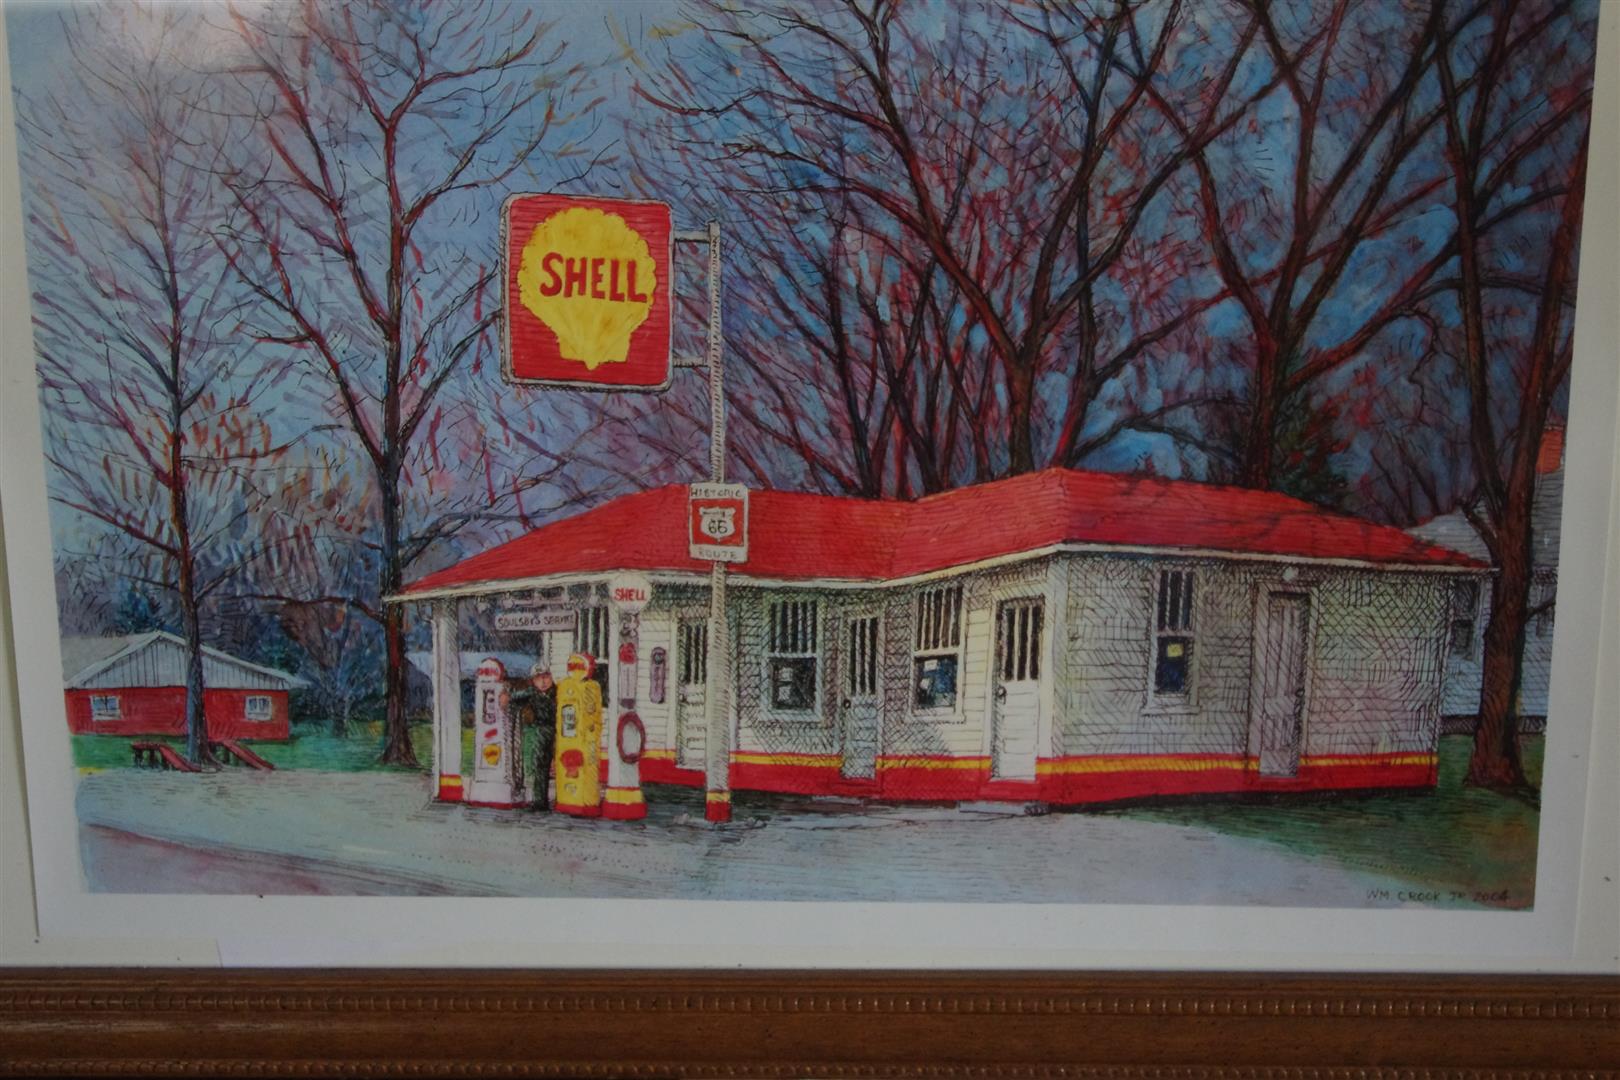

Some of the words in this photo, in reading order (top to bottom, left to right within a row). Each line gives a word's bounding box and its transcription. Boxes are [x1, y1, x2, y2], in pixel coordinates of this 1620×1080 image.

[540, 252, 647, 303] SHELL
[708, 518, 728, 534] 66
[614, 588, 646, 601] SHELL
